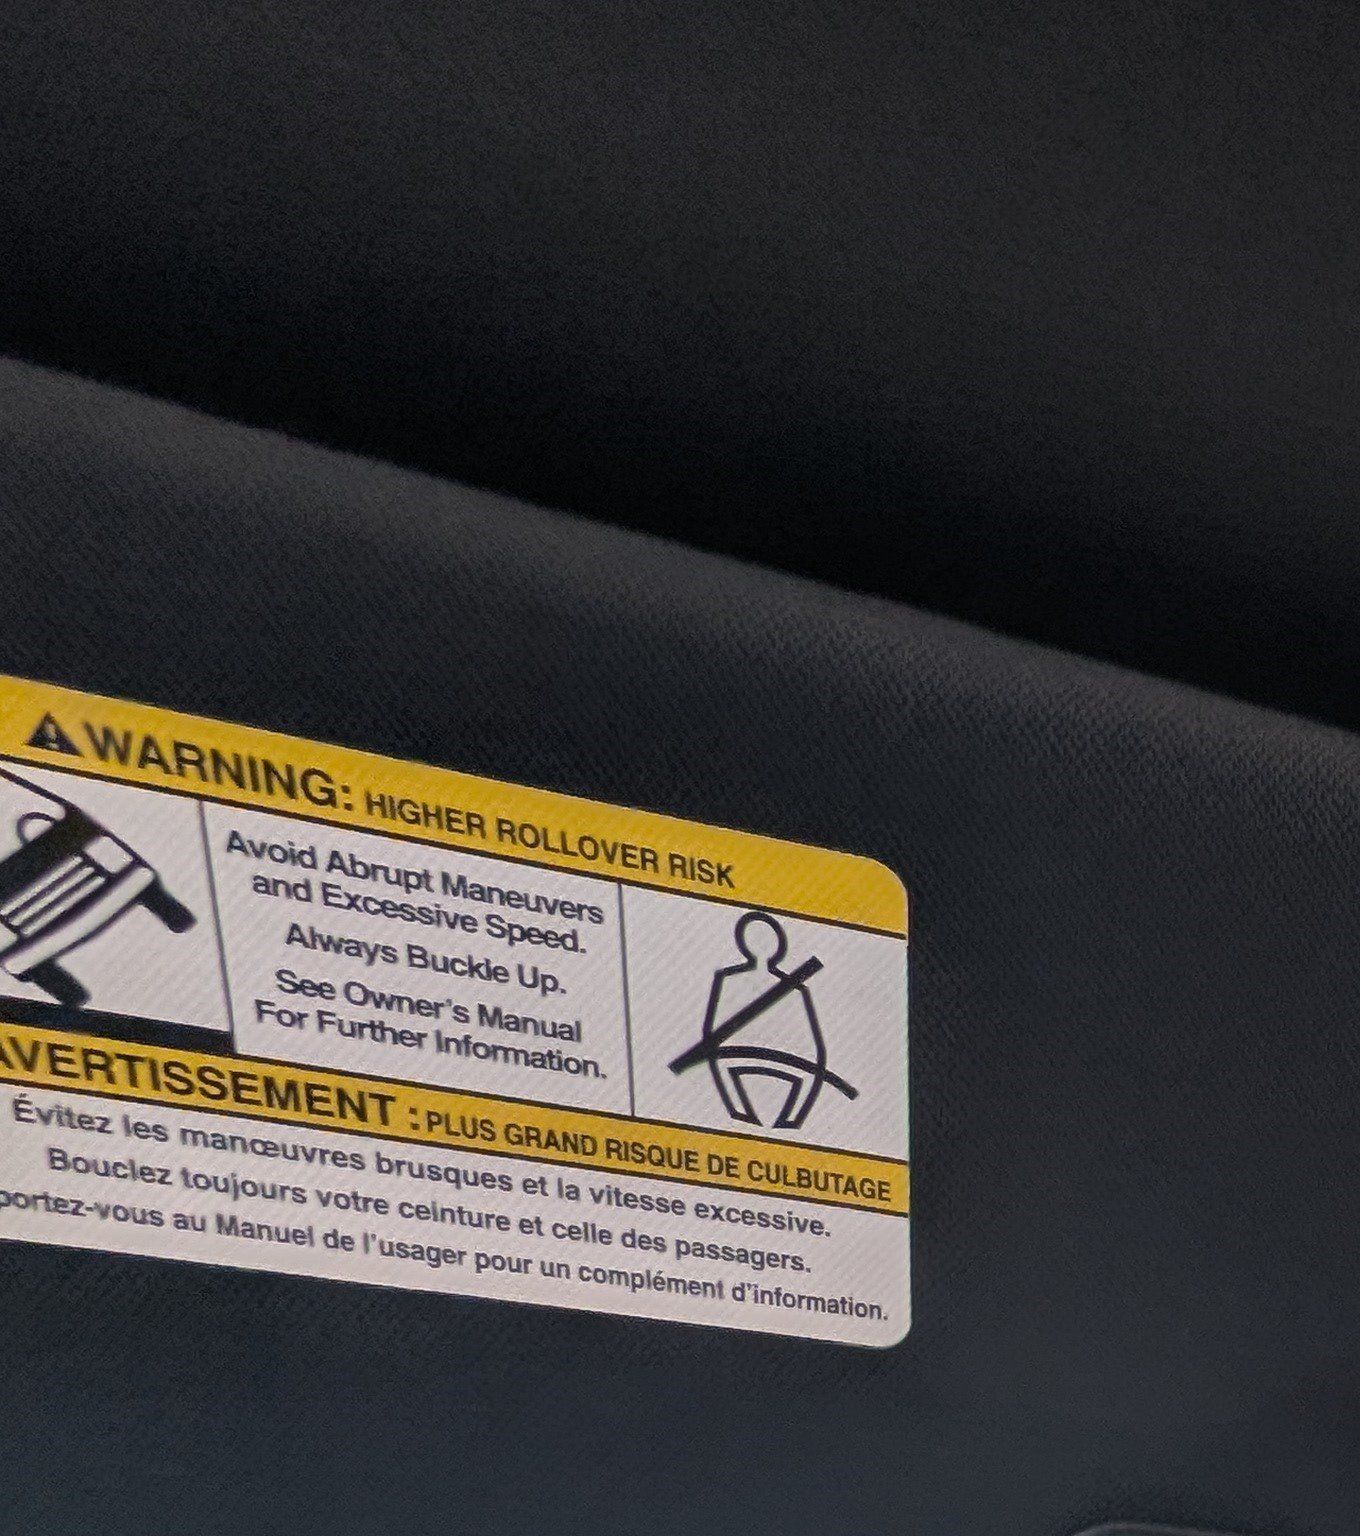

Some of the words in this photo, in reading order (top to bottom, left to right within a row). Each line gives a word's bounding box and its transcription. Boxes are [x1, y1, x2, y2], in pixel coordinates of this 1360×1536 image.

[84, 721, 354, 811] WARNING:
[364, 790, 487, 838] HIGHER
[496, 817, 658, 872] ROLLOVER
[669, 853, 735, 889] RISK
[226, 829, 316, 871] Avoid
[325, 850, 432, 893] Abrupt
[441, 872, 604, 925] Maneuvers
[252, 874, 312, 903] and
[323, 884, 479, 934] Excessive
[485, 913, 587, 954] Speed.
[275, 968, 335, 1000] See
[343, 982, 469, 1022] Owner's
[478, 1003, 581, 1042] Manual
[285, 922, 398, 967] Always
[406, 943, 509, 984] Buckle
[517, 963, 567, 998] Up.
[254, 998, 308, 1030] For
[317, 1007, 427, 1048] Further
[435, 1029, 607, 1080] Information.
[12, 1093, 114, 1134] Évitez
[123, 1116, 168, 1142] les
[180, 1126, 366, 1172] manœuvres
[375, 1151, 512, 1194] brusques
[522, 1176, 548, 1198] et
[557, 1177, 580, 1201] la
[589, 1184, 686, 1216] vitesse
[694, 1203, 831, 1238] excessive.
[427, 1108, 496, 1142] PLUS
[504, 1121, 598, 1157] GRAND
[605, 1137, 699, 1173] RISQUE
[707, 1153, 740, 1180] DE
[748, 1158, 891, 1202] CULBUTAGE
[48, 1147, 172, 1186] Bouclez
[181, 1166, 307, 1205] toujours
[316, 1188, 390, 1216] votre
[398, 1199, 511, 1233] ceinture
[518, 1216, 544, 1237] et
[551, 1220, 612, 1247] celle
[621, 1228, 667, 1253] des
[674, 1237, 812, 1276] passagers.
[173, 1210, 206, 1233] au
[216, 1212, 314, 1248] Manuel
[323, 1229, 356, 1253] de
[474, 1250, 533, 1276] pour
[540, 1260, 570, 1282] un
[578, 1263, 724, 1301] complément
